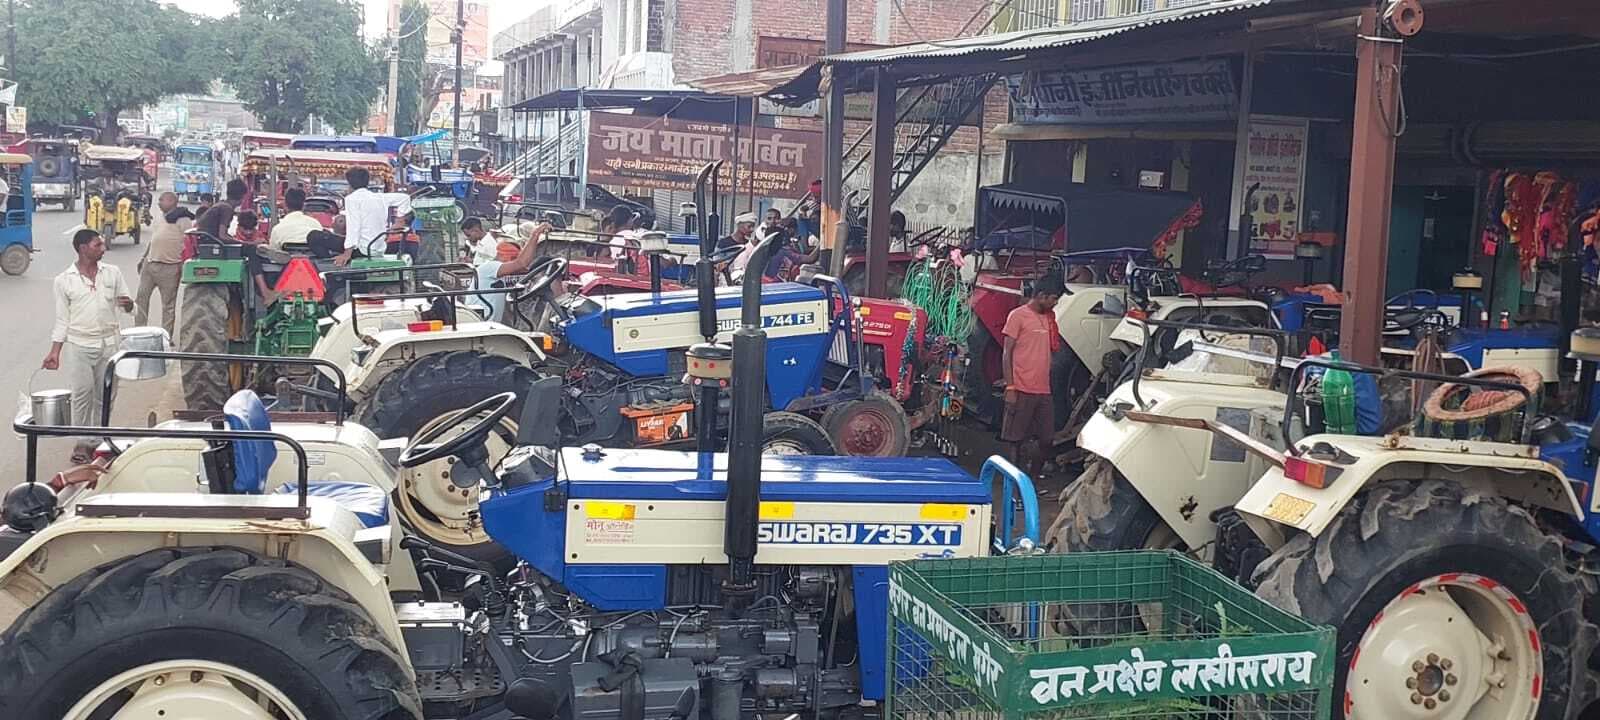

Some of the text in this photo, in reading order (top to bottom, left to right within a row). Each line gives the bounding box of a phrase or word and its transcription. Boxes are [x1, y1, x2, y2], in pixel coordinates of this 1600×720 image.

[600, 125, 807, 168] जय माता मार्बल
[769, 315, 793, 326] 744
[797, 313, 812, 325] FE
[862, 524, 912, 544] 735
[916, 524, 958, 544] XT
[1029, 665, 1089, 705] वन
